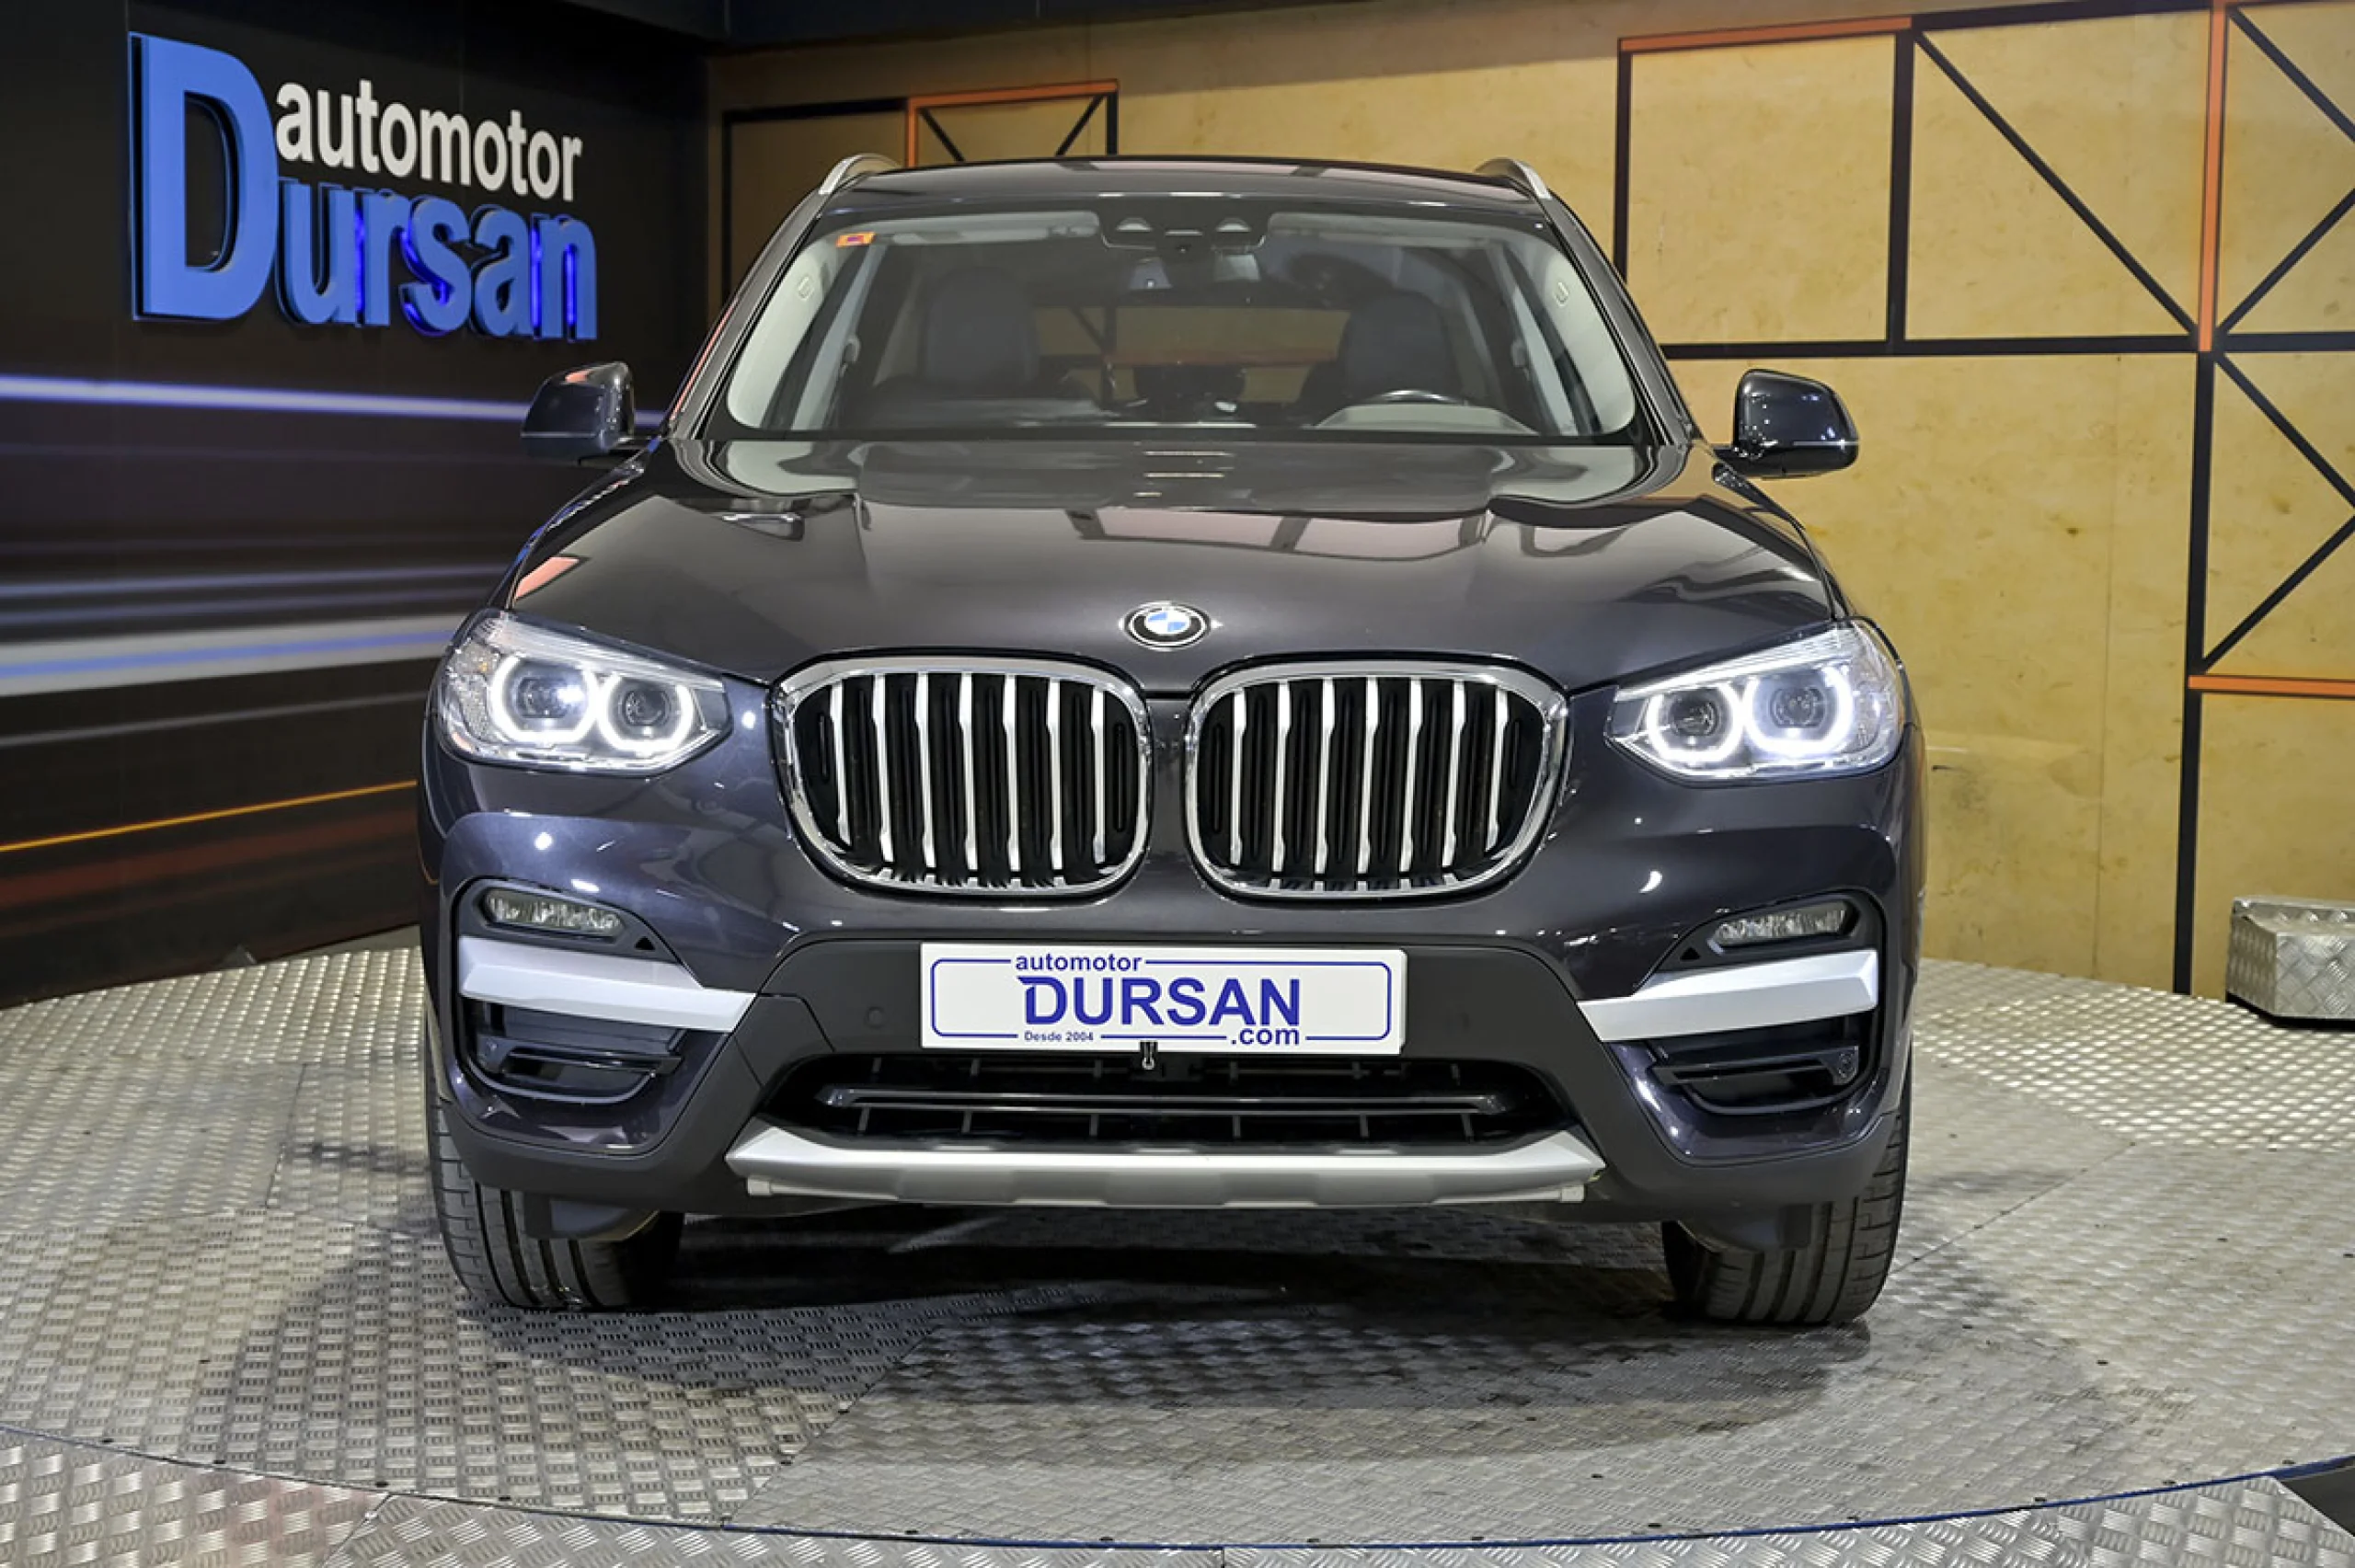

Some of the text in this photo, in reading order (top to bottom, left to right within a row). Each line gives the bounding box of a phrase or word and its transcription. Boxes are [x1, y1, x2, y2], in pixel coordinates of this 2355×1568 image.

[276, 78, 583, 201] automotor
[129, 31, 597, 342] Dursan
[1015, 953, 1143, 972] automotor
[1017, 975, 1301, 1027] DURSAN
[1024, 1031, 1095, 1043] Desde 2004
[1230, 1025, 1300, 1046] .com
